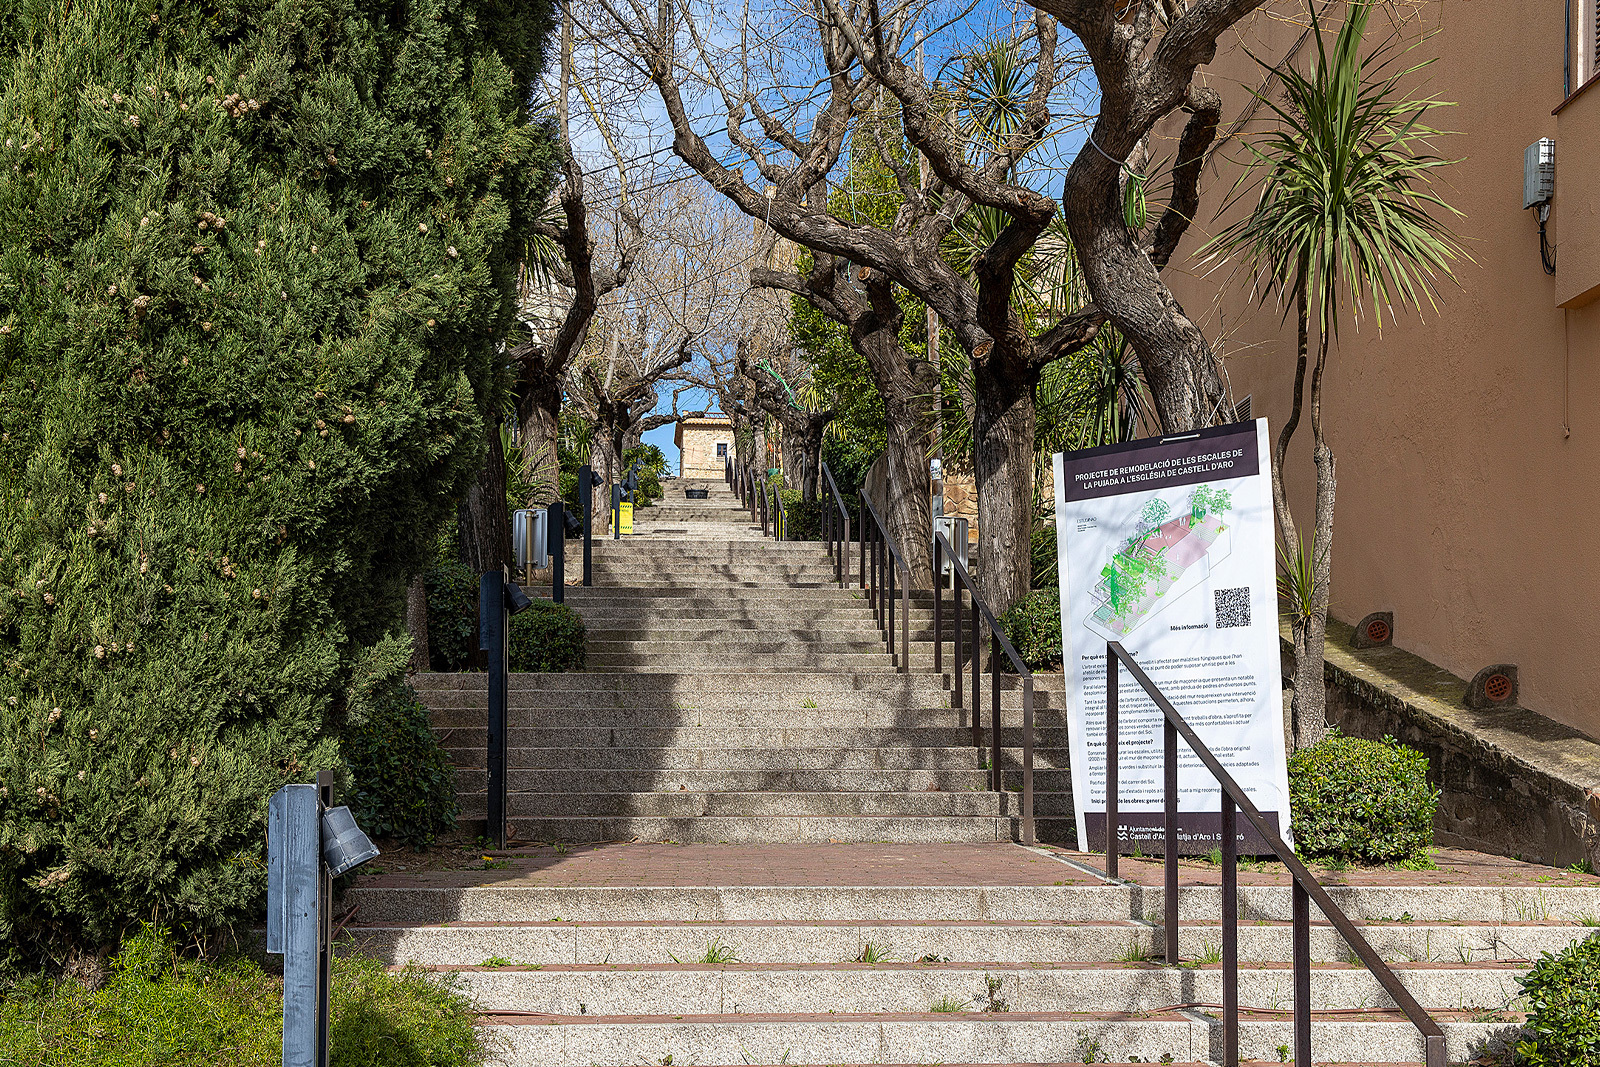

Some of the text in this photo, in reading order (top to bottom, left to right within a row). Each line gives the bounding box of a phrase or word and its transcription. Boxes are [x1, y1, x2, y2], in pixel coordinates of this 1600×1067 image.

[1075, 449, 1243, 481] PROJECTE DE REMODELACIÓ DE LES ESCALES DE
[1093, 479, 1119, 488] PUJADA
[1127, 470, 1166, 483] L'ESGLÉSIA
[1167, 469, 1177, 477] DE
[1178, 464, 1210, 475] CASTELL
[1212, 461, 1233, 470] D'ARO
